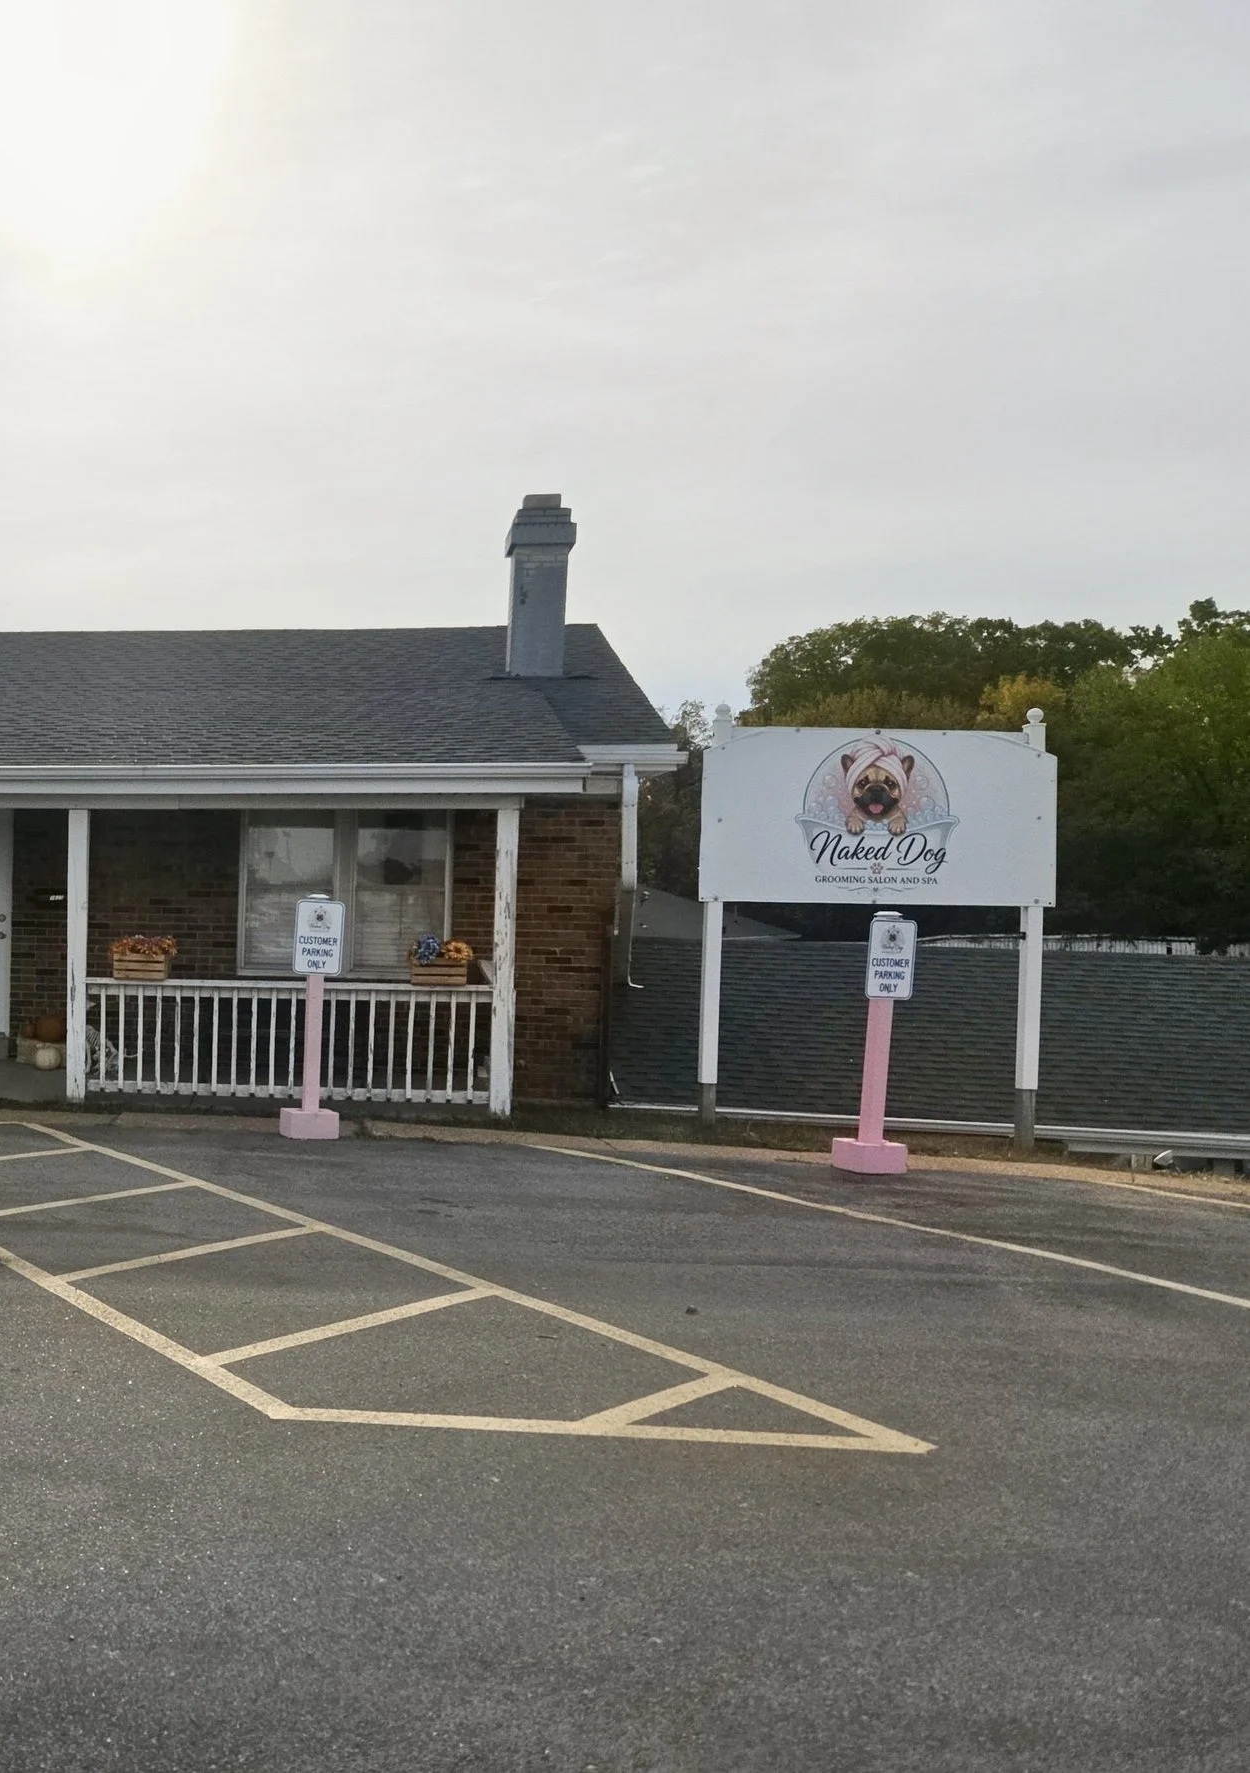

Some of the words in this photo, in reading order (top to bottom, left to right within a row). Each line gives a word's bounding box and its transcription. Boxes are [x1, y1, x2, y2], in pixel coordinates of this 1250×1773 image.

[809, 830, 894, 867] Naked
[896, 832, 949, 875] Dog
[814, 875, 866, 884] GROOMING
[867, 876, 898, 885] SALON
[900, 876, 920, 885] AND
[922, 877, 938, 885] SPA
[298, 935, 338, 947] CUSTOMER
[301, 946, 334, 958] PARKING
[307, 959, 327, 970] ONLY
[871, 957, 910, 969] CUSTOMER
[874, 970, 905, 981] PARKING
[879, 982, 898, 993] ONLY
